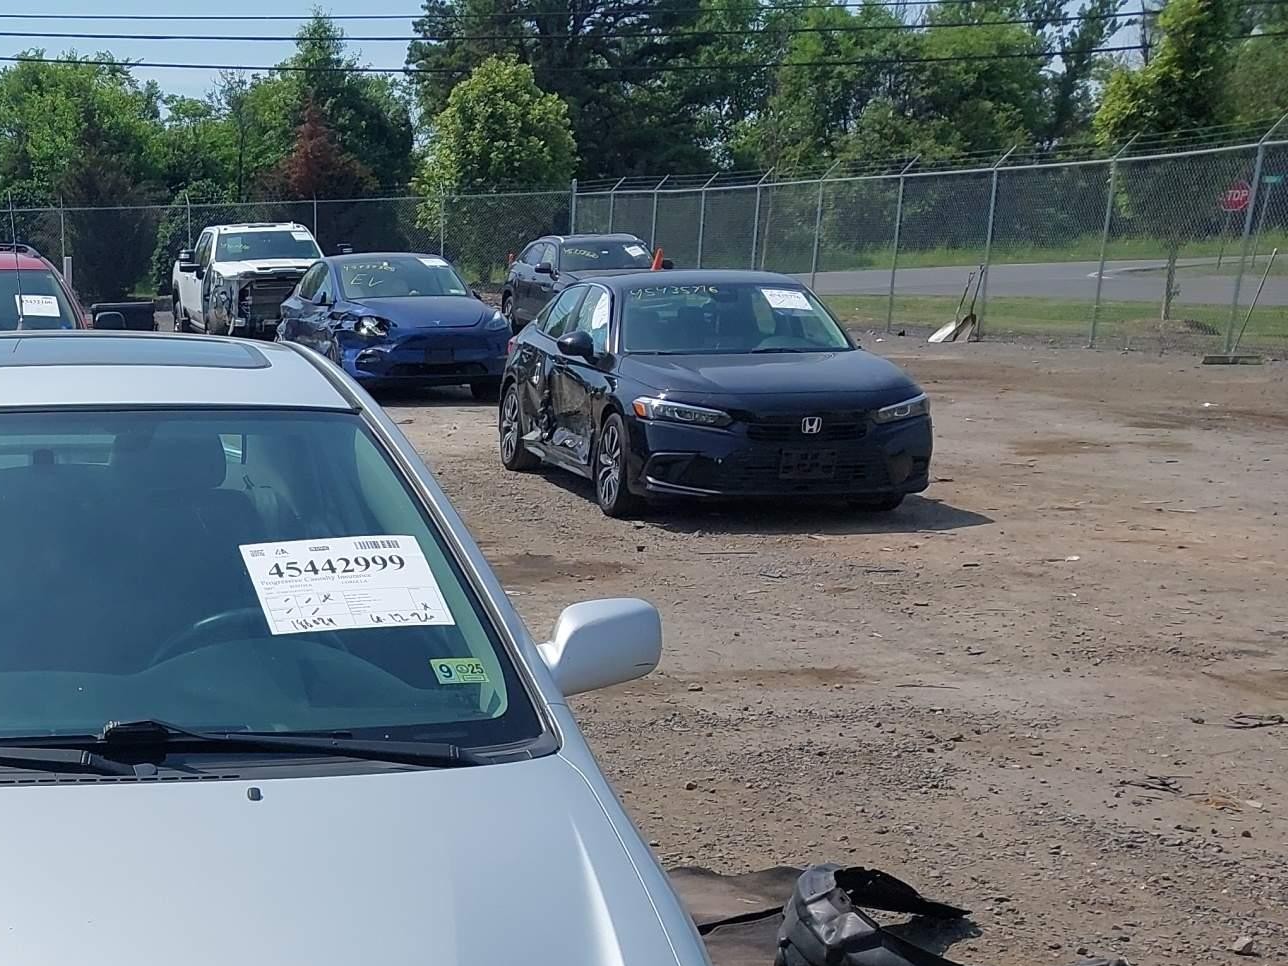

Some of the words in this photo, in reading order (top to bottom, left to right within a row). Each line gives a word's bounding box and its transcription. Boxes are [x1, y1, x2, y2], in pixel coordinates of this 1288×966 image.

[1224, 190, 1249, 201] TOP
[269, 554, 405, 578] 45442999
[439, 664, 452, 678] 9
[468, 664, 484, 674] 25
